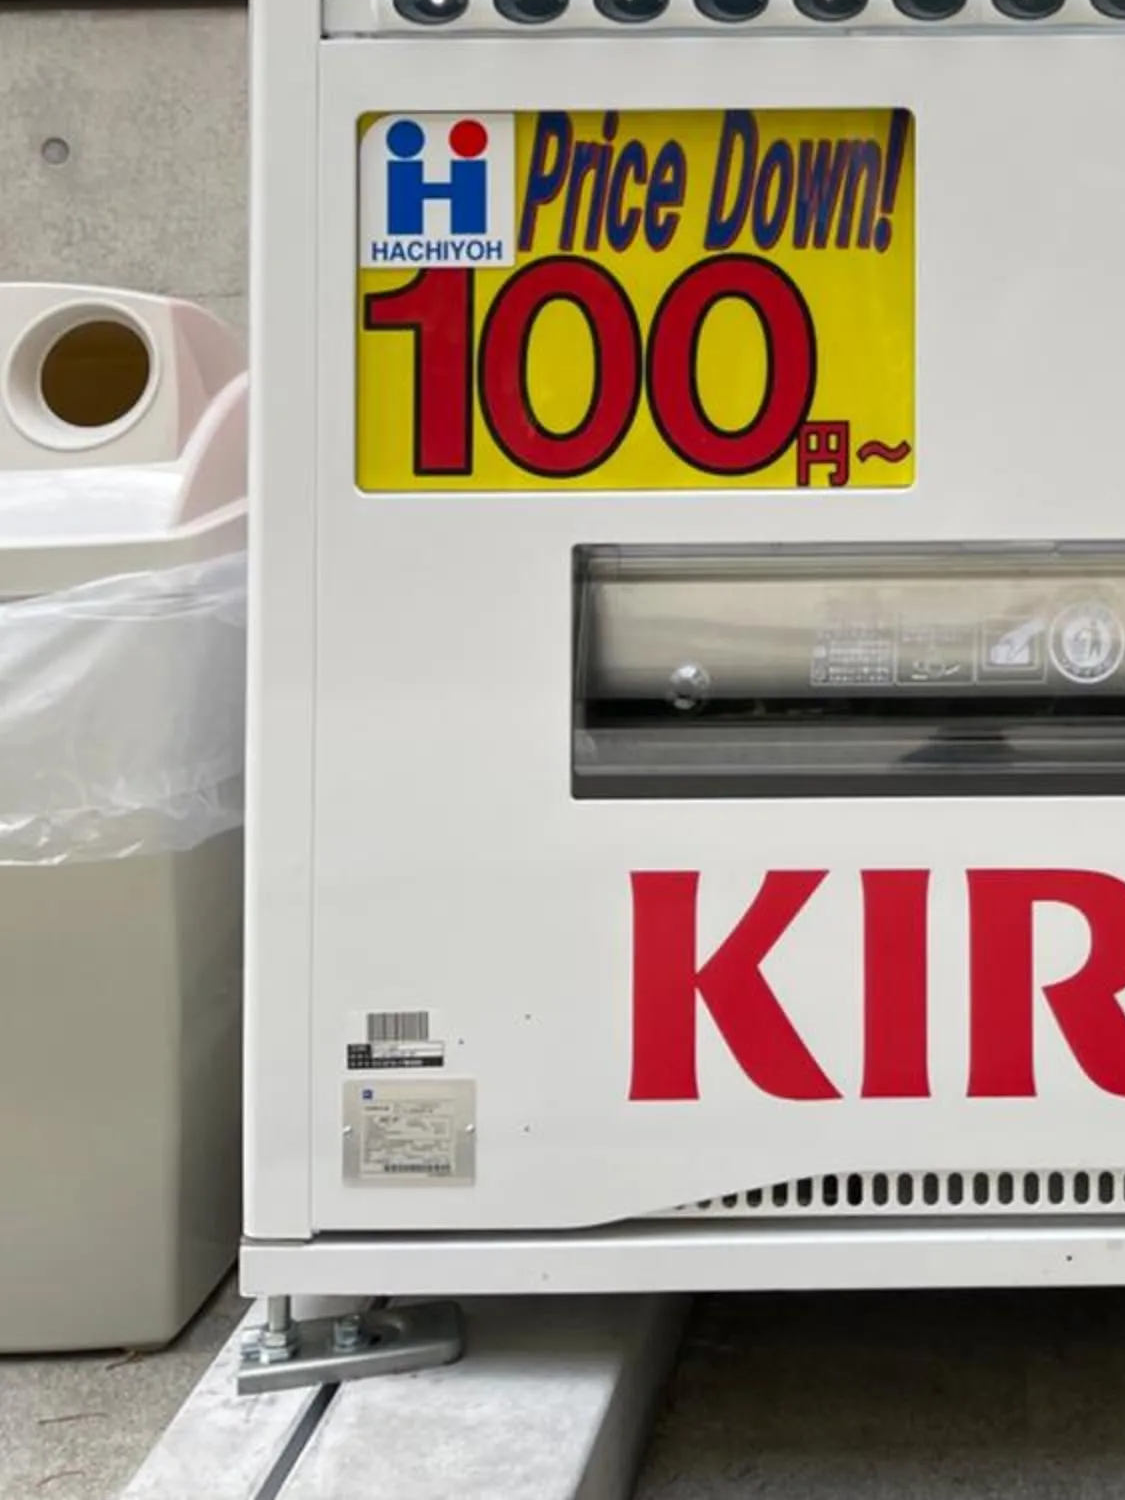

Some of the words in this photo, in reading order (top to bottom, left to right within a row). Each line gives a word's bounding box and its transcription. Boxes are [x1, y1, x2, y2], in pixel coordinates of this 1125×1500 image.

[517, 111, 688, 253] Price
[702, 109, 910, 253] Down!
[371, 240, 503, 262] HACHIYOH
